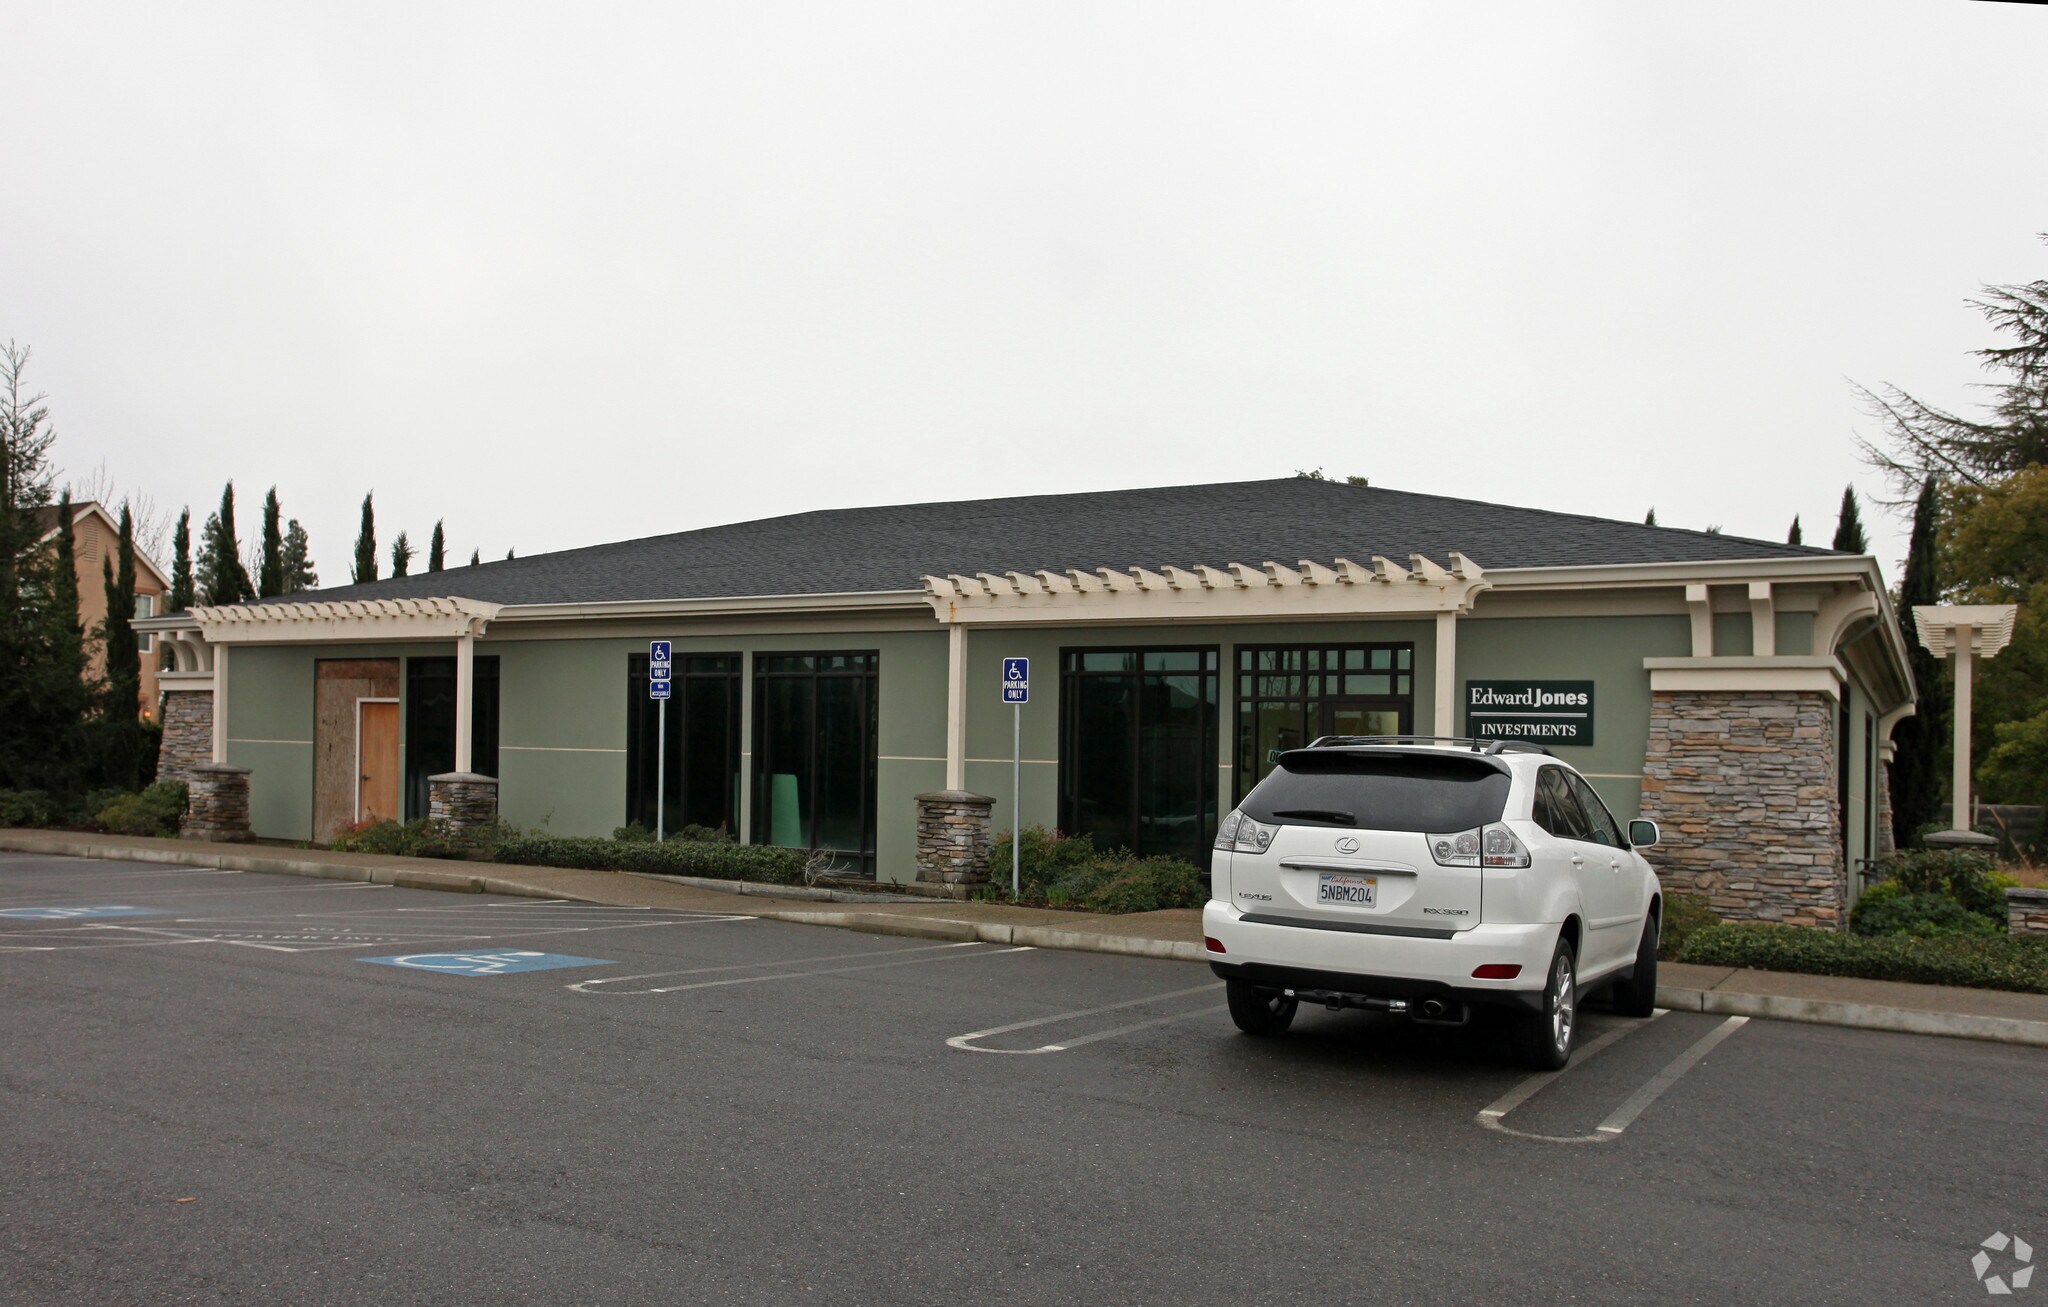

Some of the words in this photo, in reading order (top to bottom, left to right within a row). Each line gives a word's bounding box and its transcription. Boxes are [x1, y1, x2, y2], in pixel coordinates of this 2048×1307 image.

[1004, 680, 1027, 689] PARKING
[1008, 690, 1023, 698] ONLY
[1470, 687, 1533, 705] Edward
[1533, 688, 1588, 708] Jones
[1481, 723, 1577, 736] INVESTMENTS
[1321, 884, 1372, 903] 5NBM204
